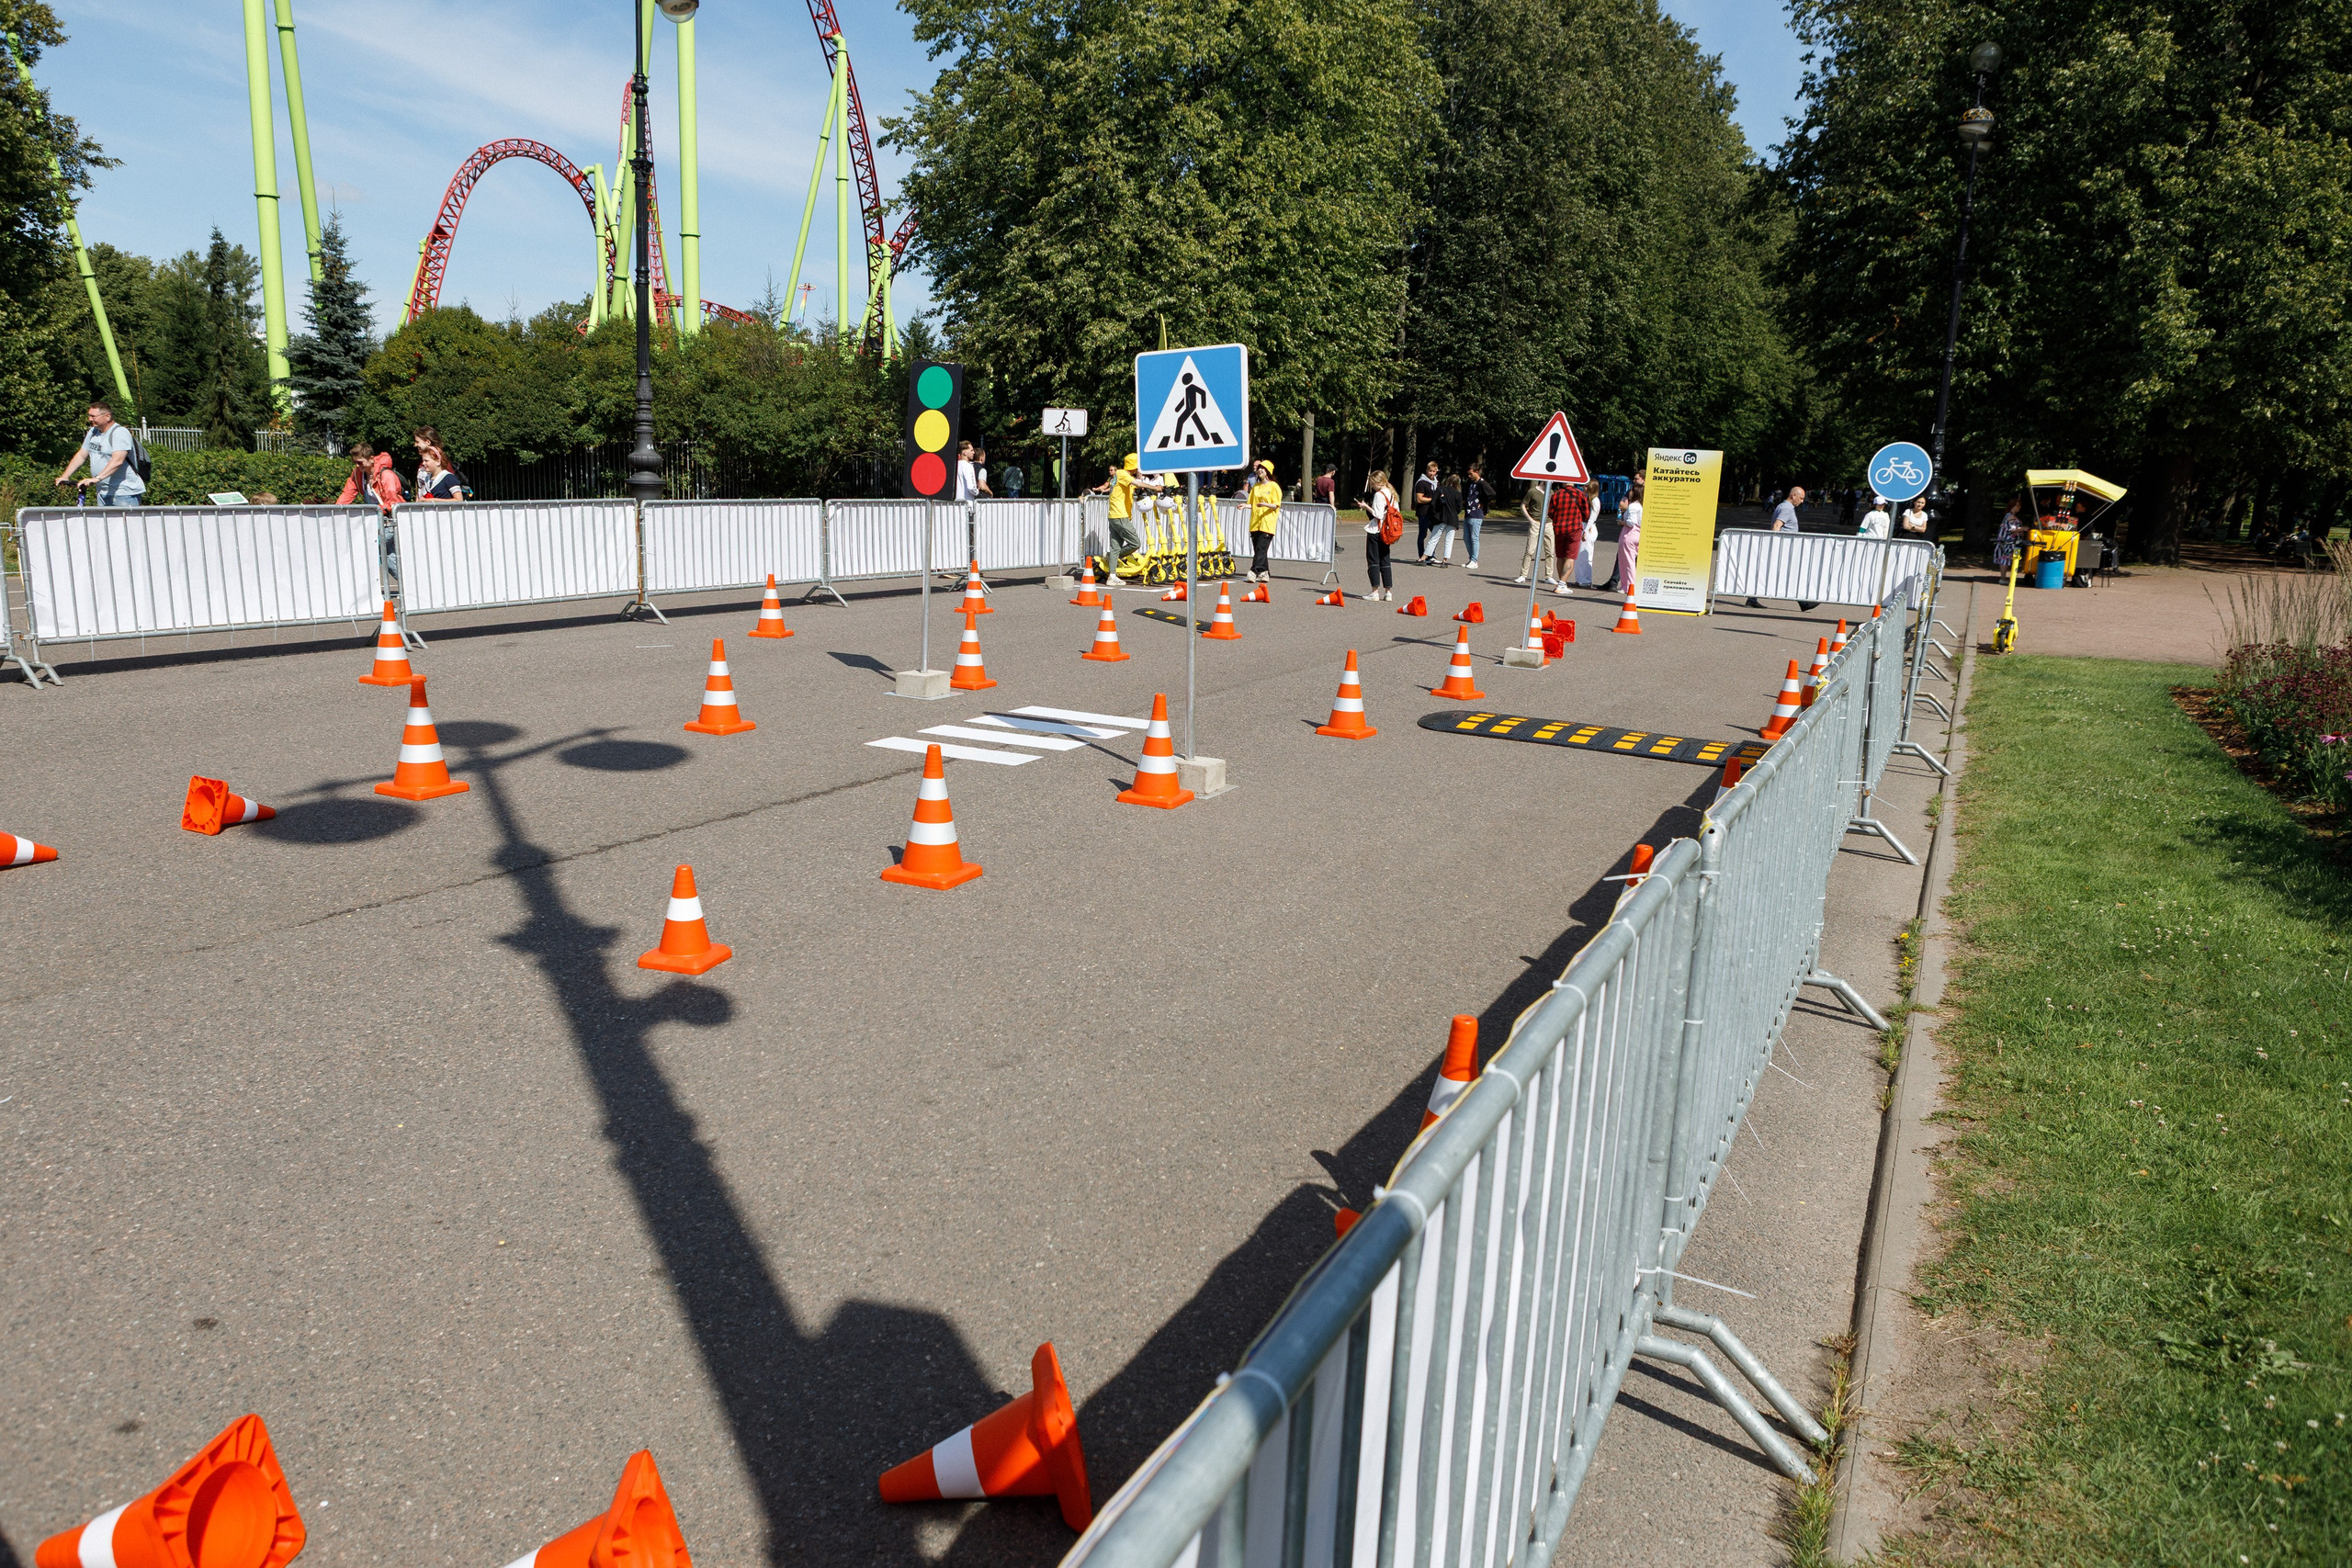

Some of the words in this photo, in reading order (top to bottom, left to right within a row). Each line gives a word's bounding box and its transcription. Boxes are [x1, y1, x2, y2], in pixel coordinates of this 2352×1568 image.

[1655, 453, 1682, 462] Яндекс
[1684, 454, 1696, 463] Go
[1653, 467, 1700, 476] Катайтесь
